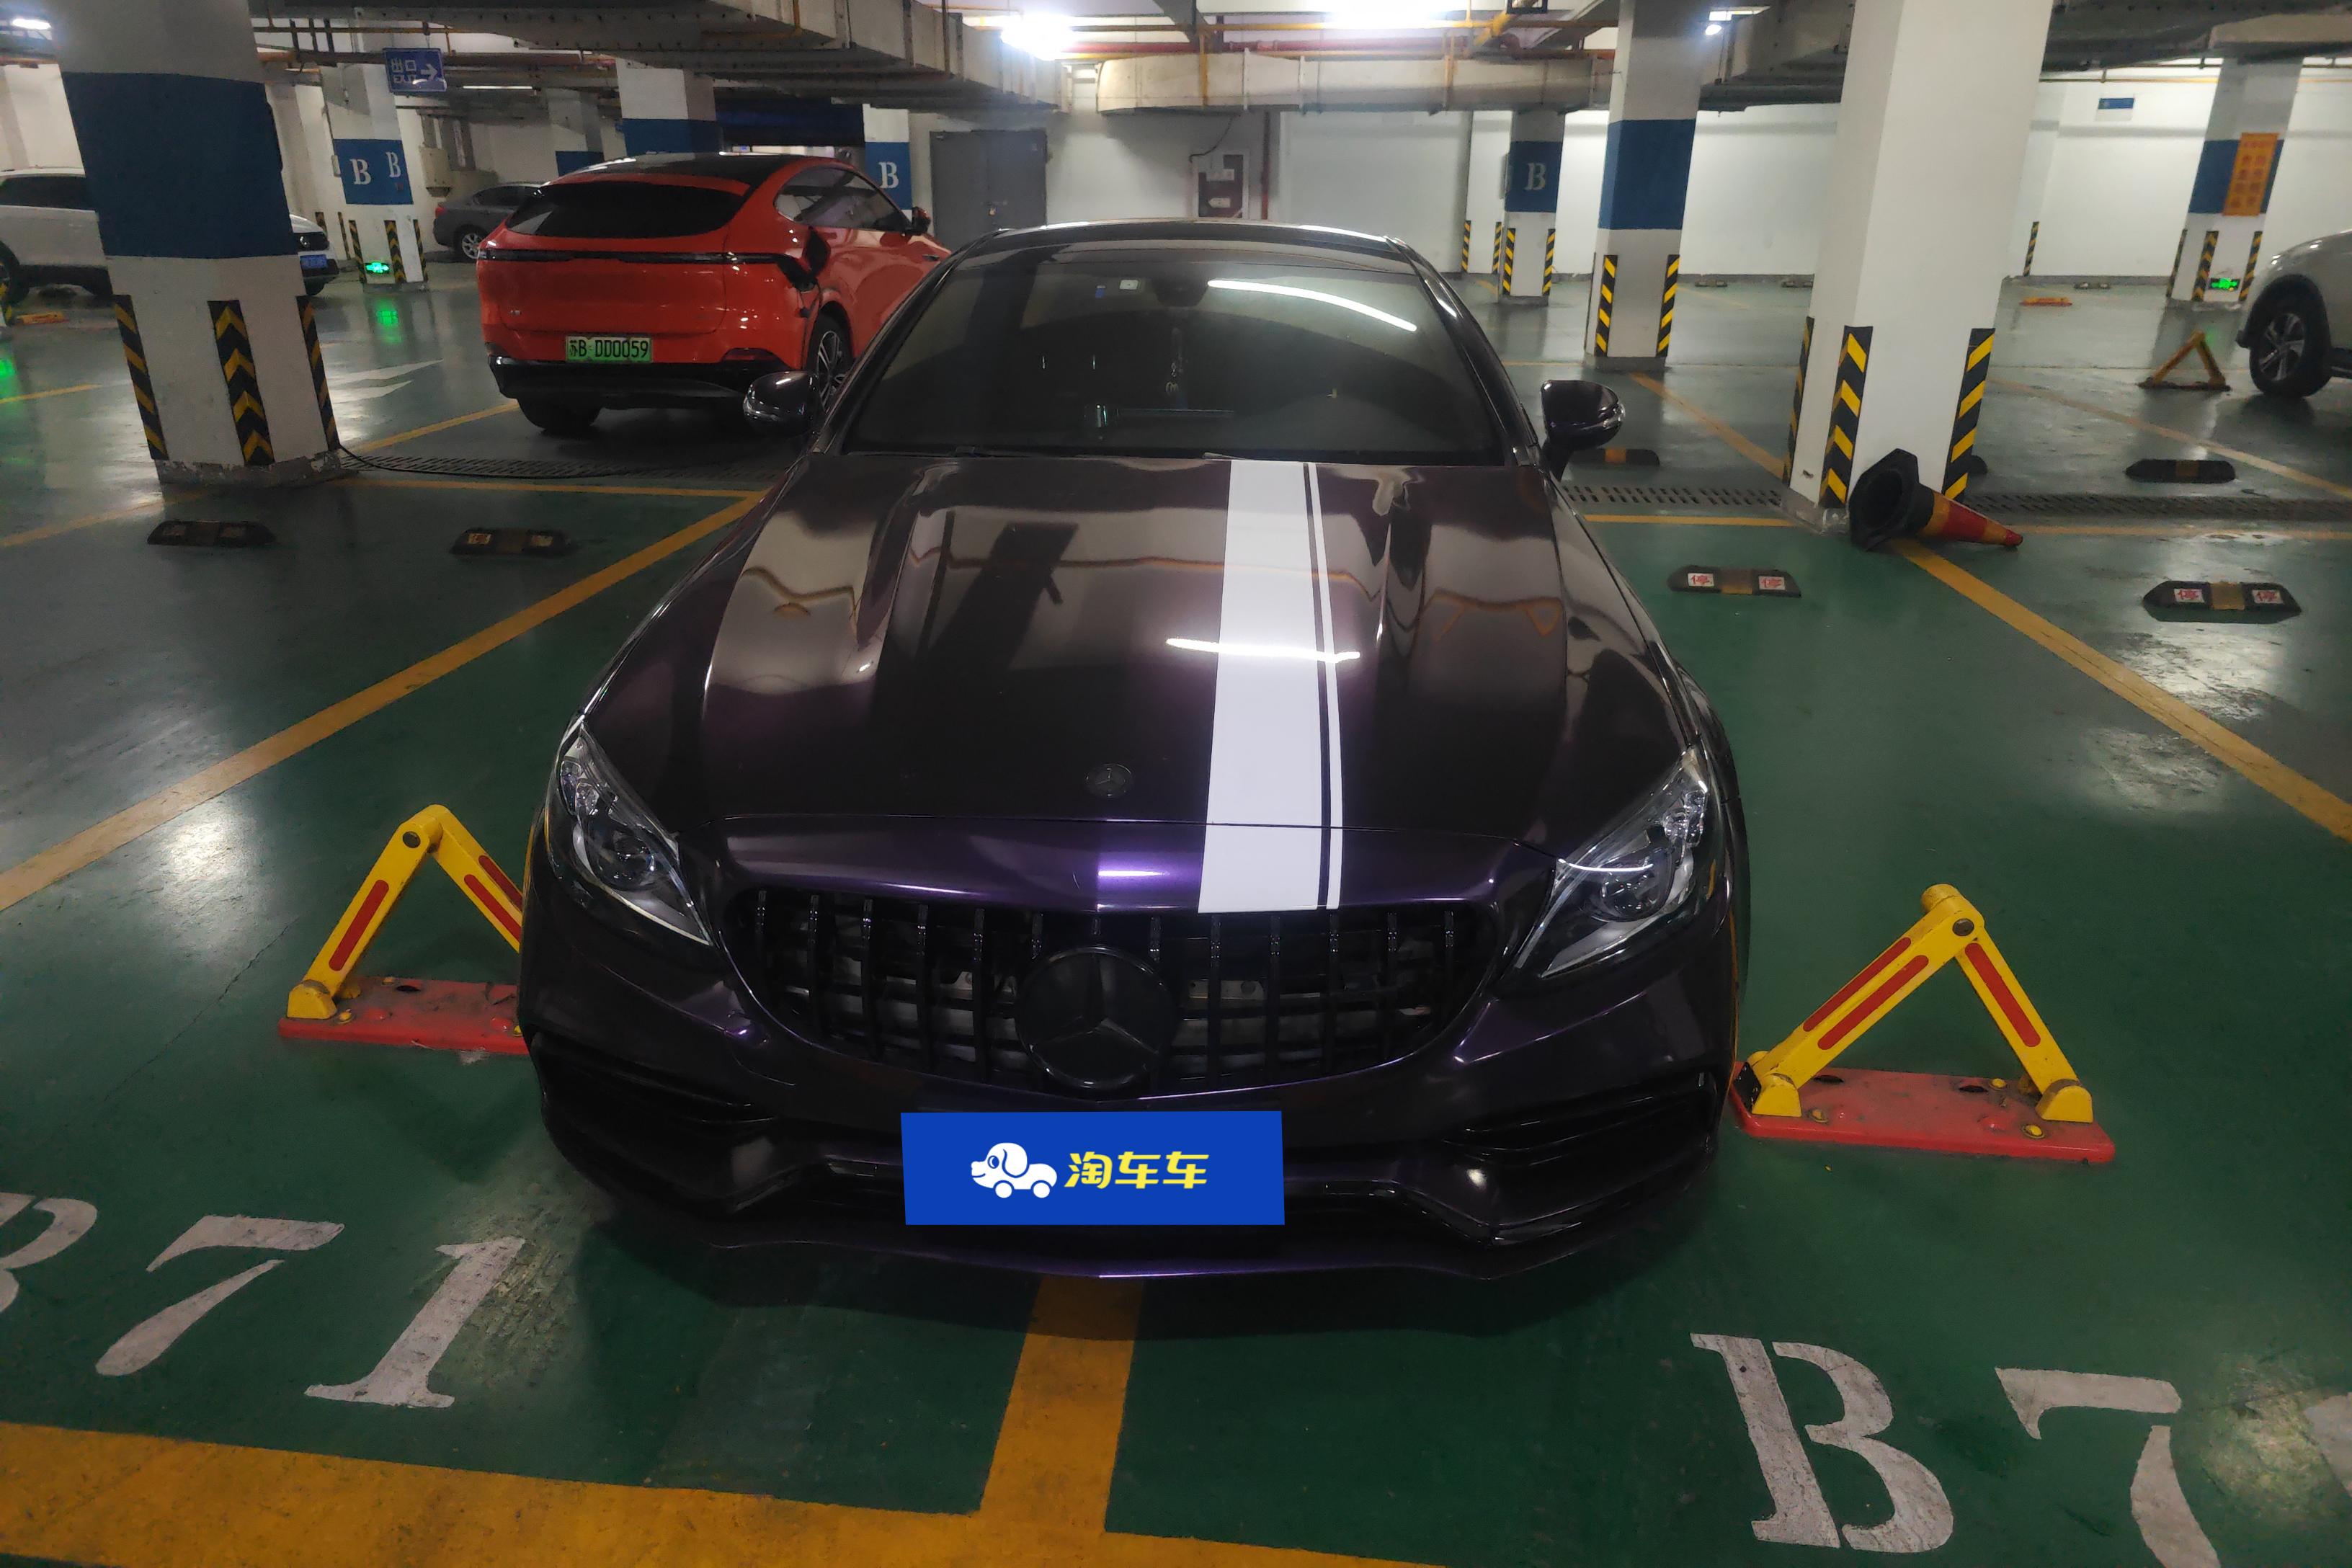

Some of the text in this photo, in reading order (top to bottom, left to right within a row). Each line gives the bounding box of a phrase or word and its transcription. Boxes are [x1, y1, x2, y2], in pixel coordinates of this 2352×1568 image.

[391, 58, 416, 72] 出口
[349, 159, 371, 184] B
[386, 151, 401, 178] B
[878, 161, 899, 189] B
[1524, 162, 1546, 191] B
